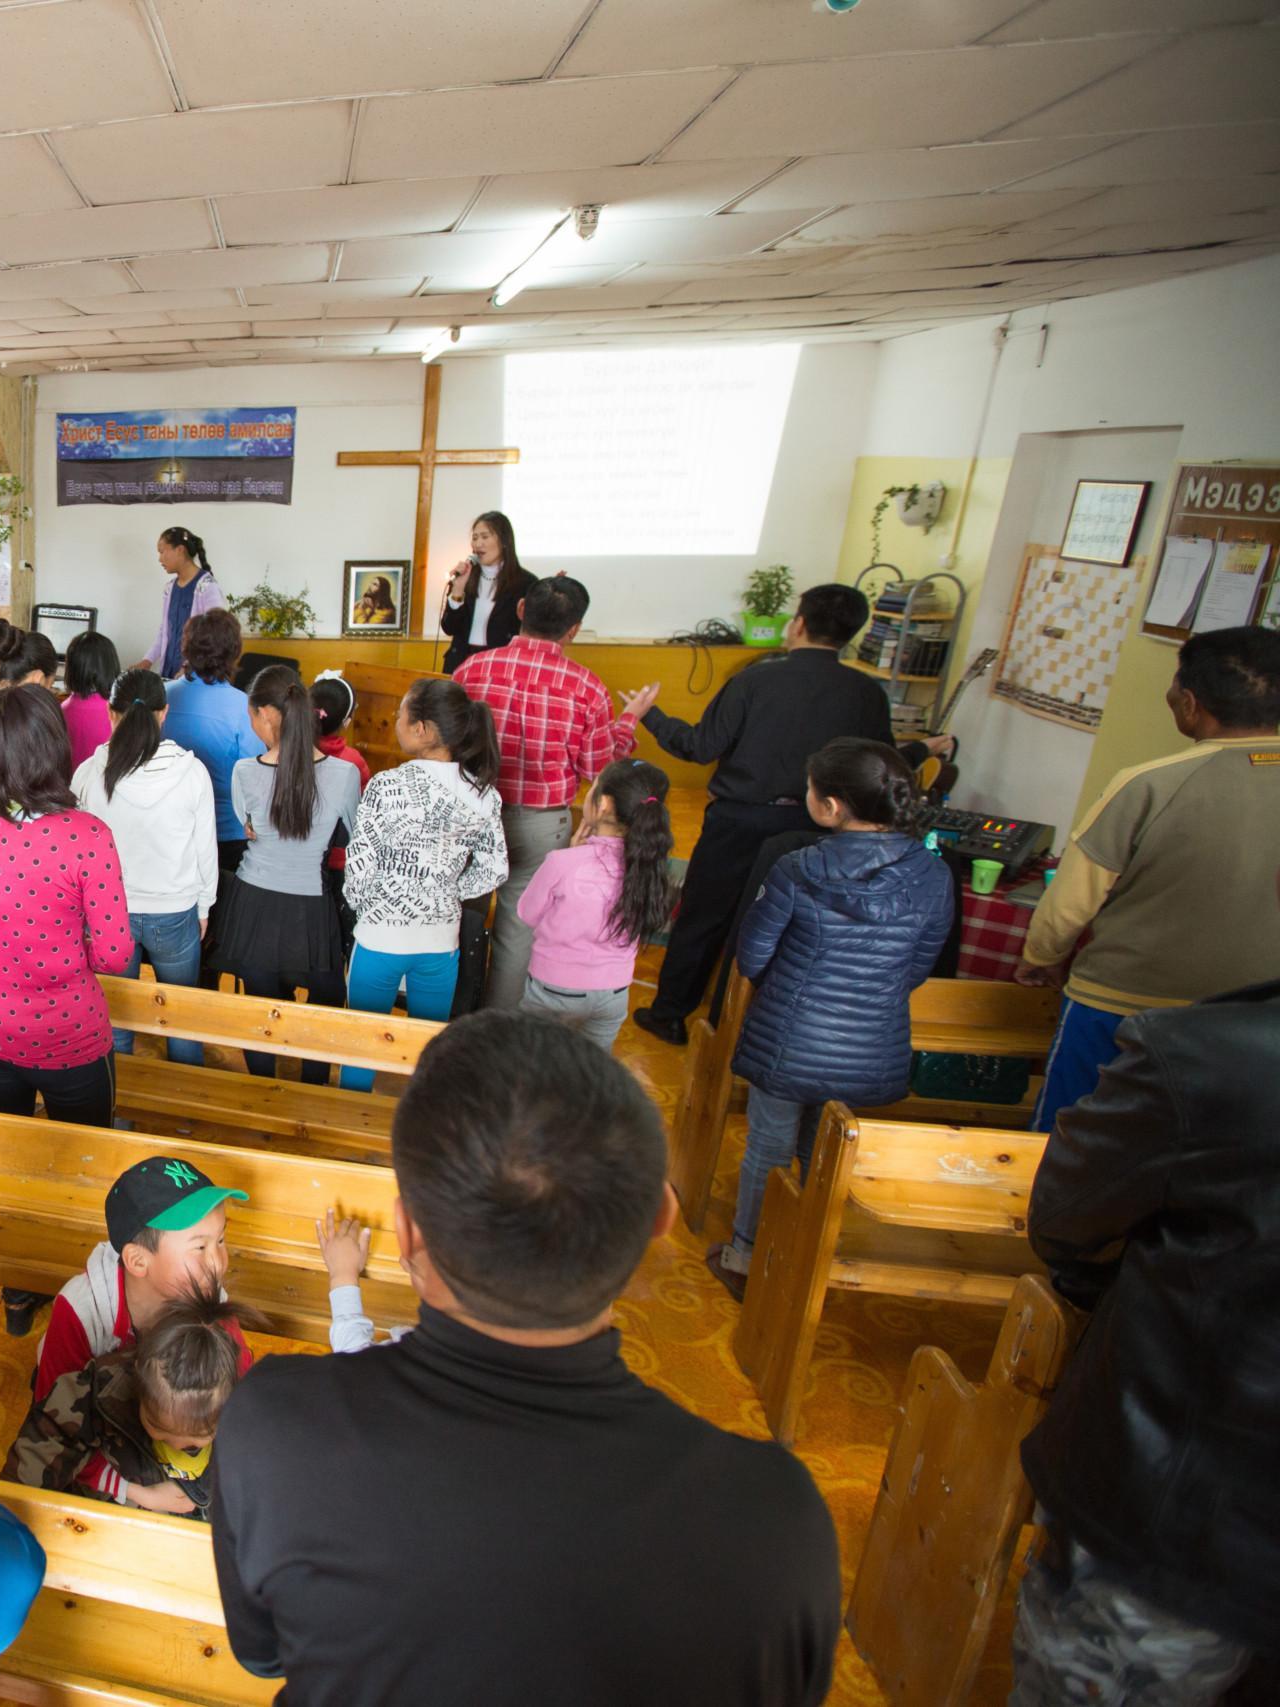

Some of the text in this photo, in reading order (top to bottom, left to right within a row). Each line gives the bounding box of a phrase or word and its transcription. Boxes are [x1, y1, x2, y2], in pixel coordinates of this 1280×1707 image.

[61, 422, 102, 447] Христ
[142, 424, 179, 440] таны
[181, 423, 225, 440] төлөө
